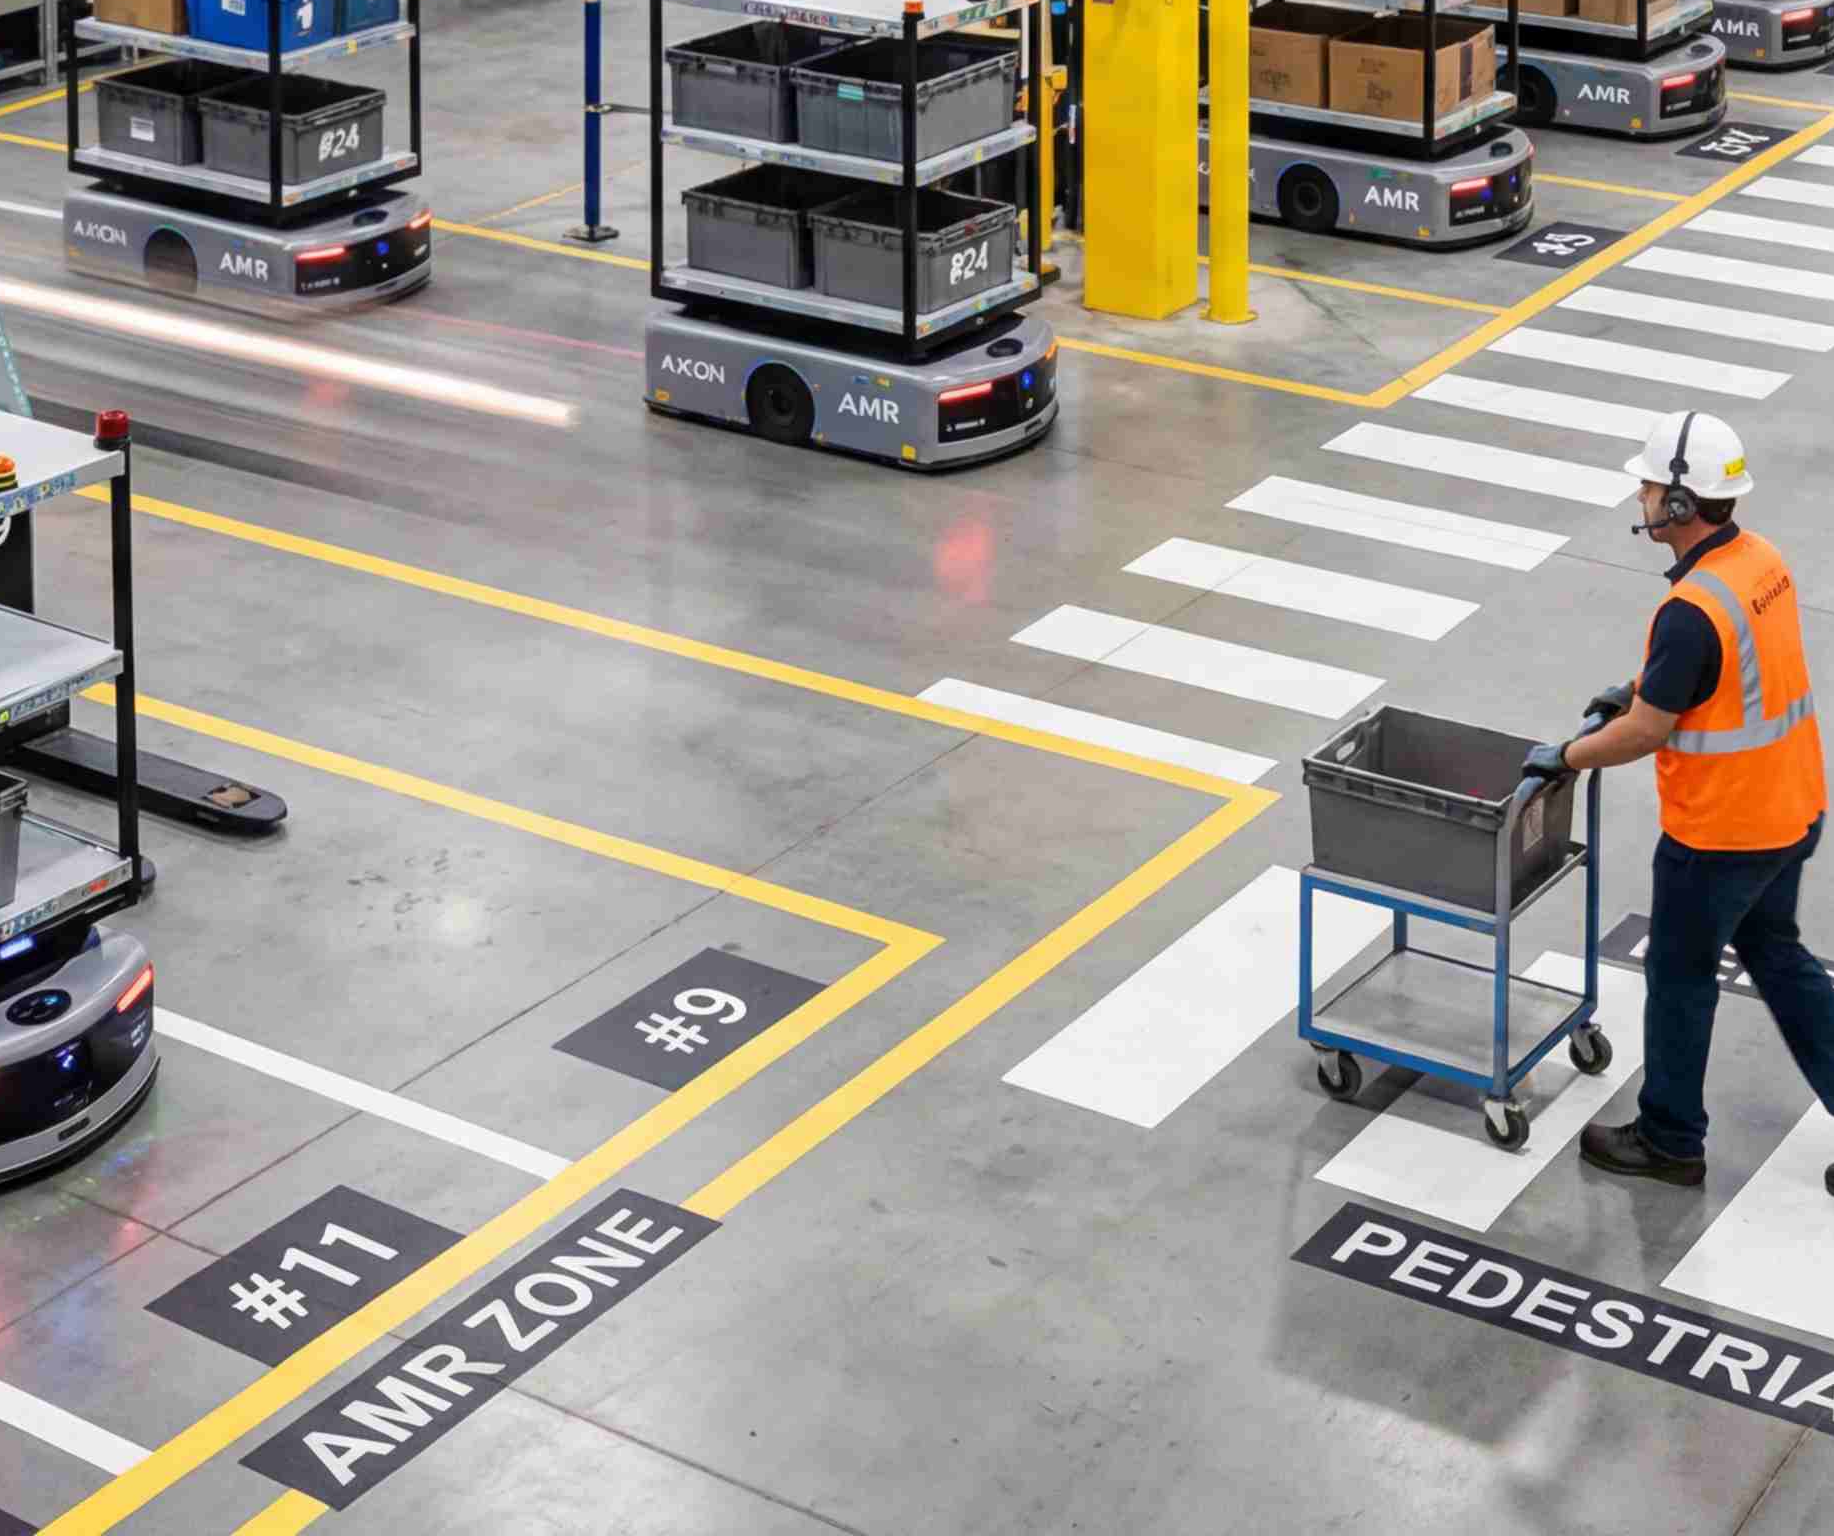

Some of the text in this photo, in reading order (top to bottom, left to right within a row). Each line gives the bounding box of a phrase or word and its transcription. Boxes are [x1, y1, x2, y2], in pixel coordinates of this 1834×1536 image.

[1712, 18, 1761, 38] AMR
[1577, 83, 1631, 105] AMR
[1364, 185, 1420, 212] AMR
[219, 251, 269, 281] AMR
[837, 392, 900, 425] AMR
[635, 987, 747, 1054] #9
[229, 1222, 399, 1330] #11
[303, 1209, 684, 1485] AMR ZONE
